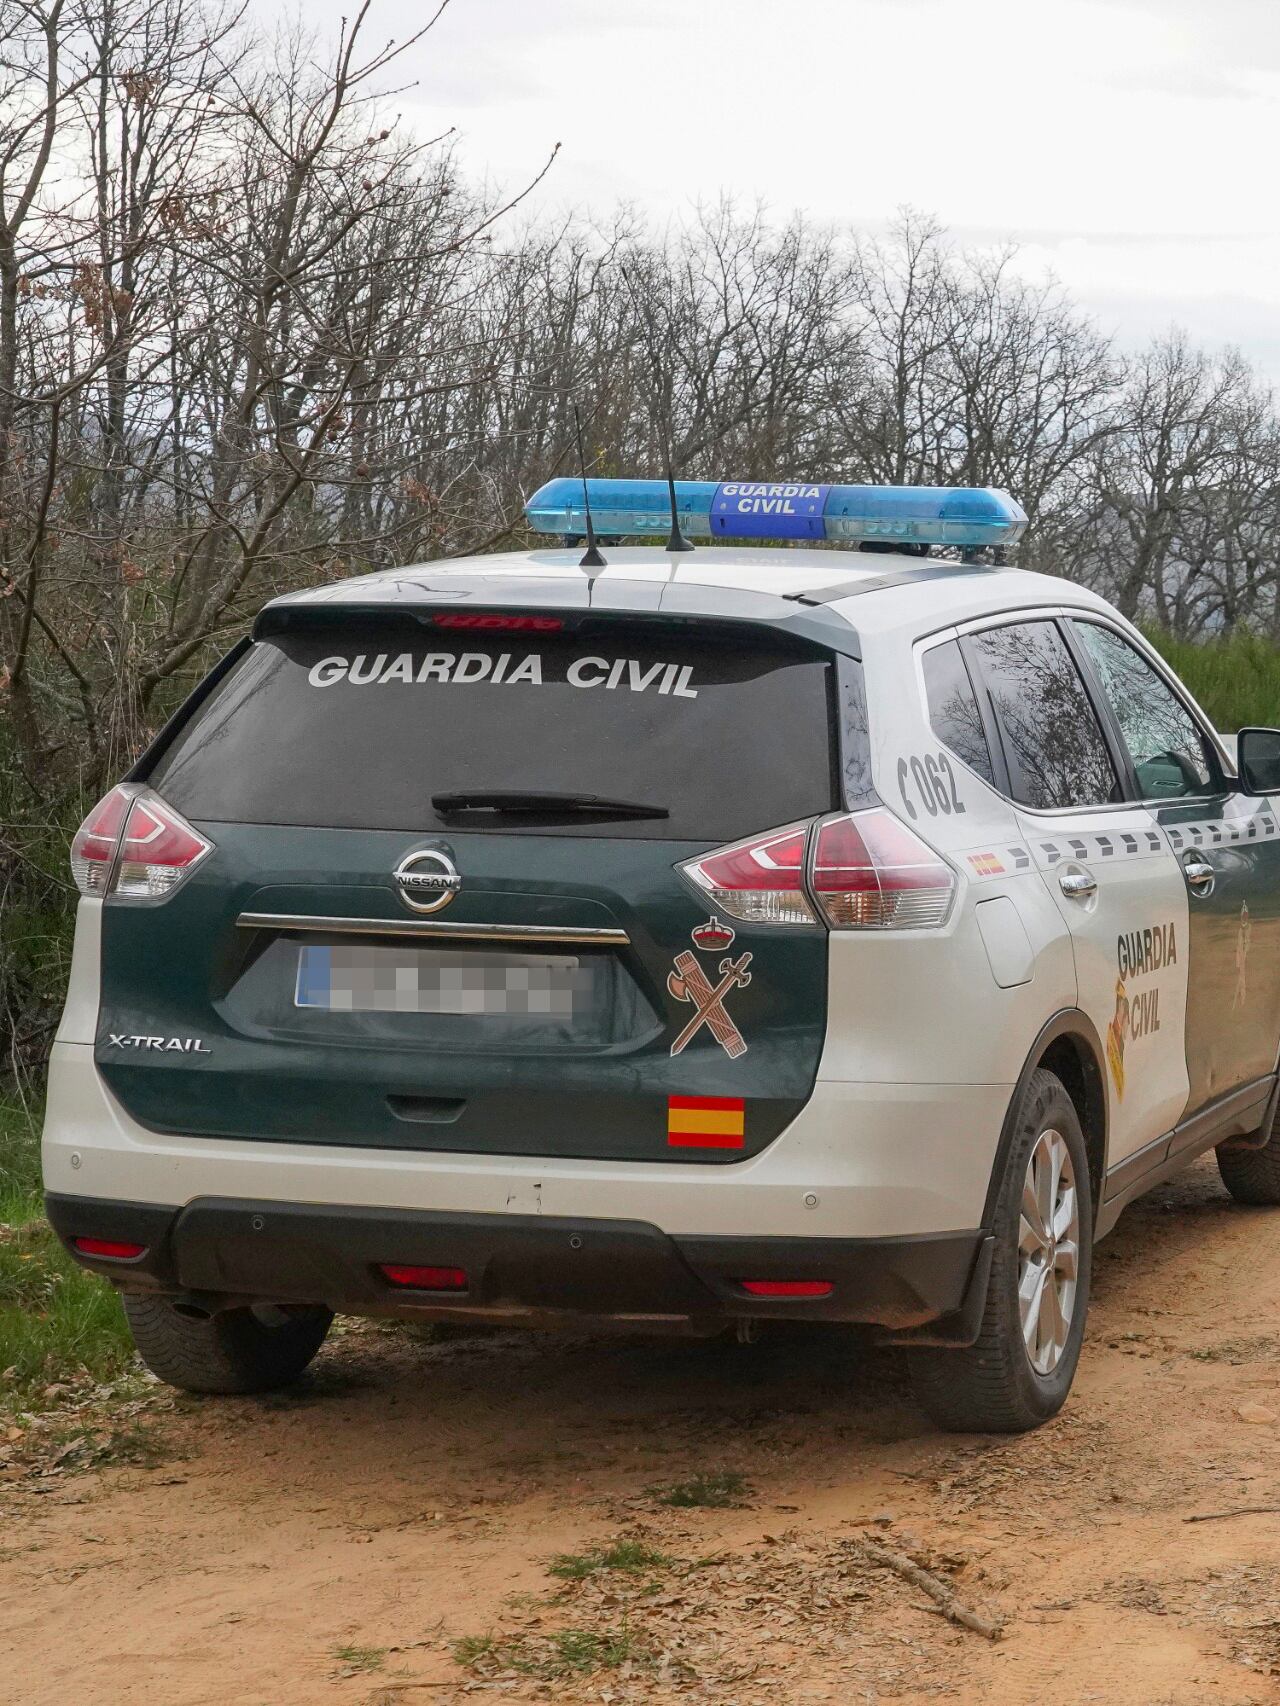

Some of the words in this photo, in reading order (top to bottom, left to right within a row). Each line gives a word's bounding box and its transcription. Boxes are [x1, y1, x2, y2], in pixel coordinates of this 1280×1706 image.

[723, 485, 820, 498] GUARDIA
[737, 498, 795, 514] CIVIL
[308, 653, 542, 687] GUARDIA
[566, 656, 698, 698] CIVIL
[910, 752, 966, 817] 062
[398, 876, 453, 888] NISSAN
[1117, 922, 1177, 982] GUARDIA
[1130, 988, 1160, 1041] CIVIL
[106, 1034, 213, 1053] X-TRAIL
